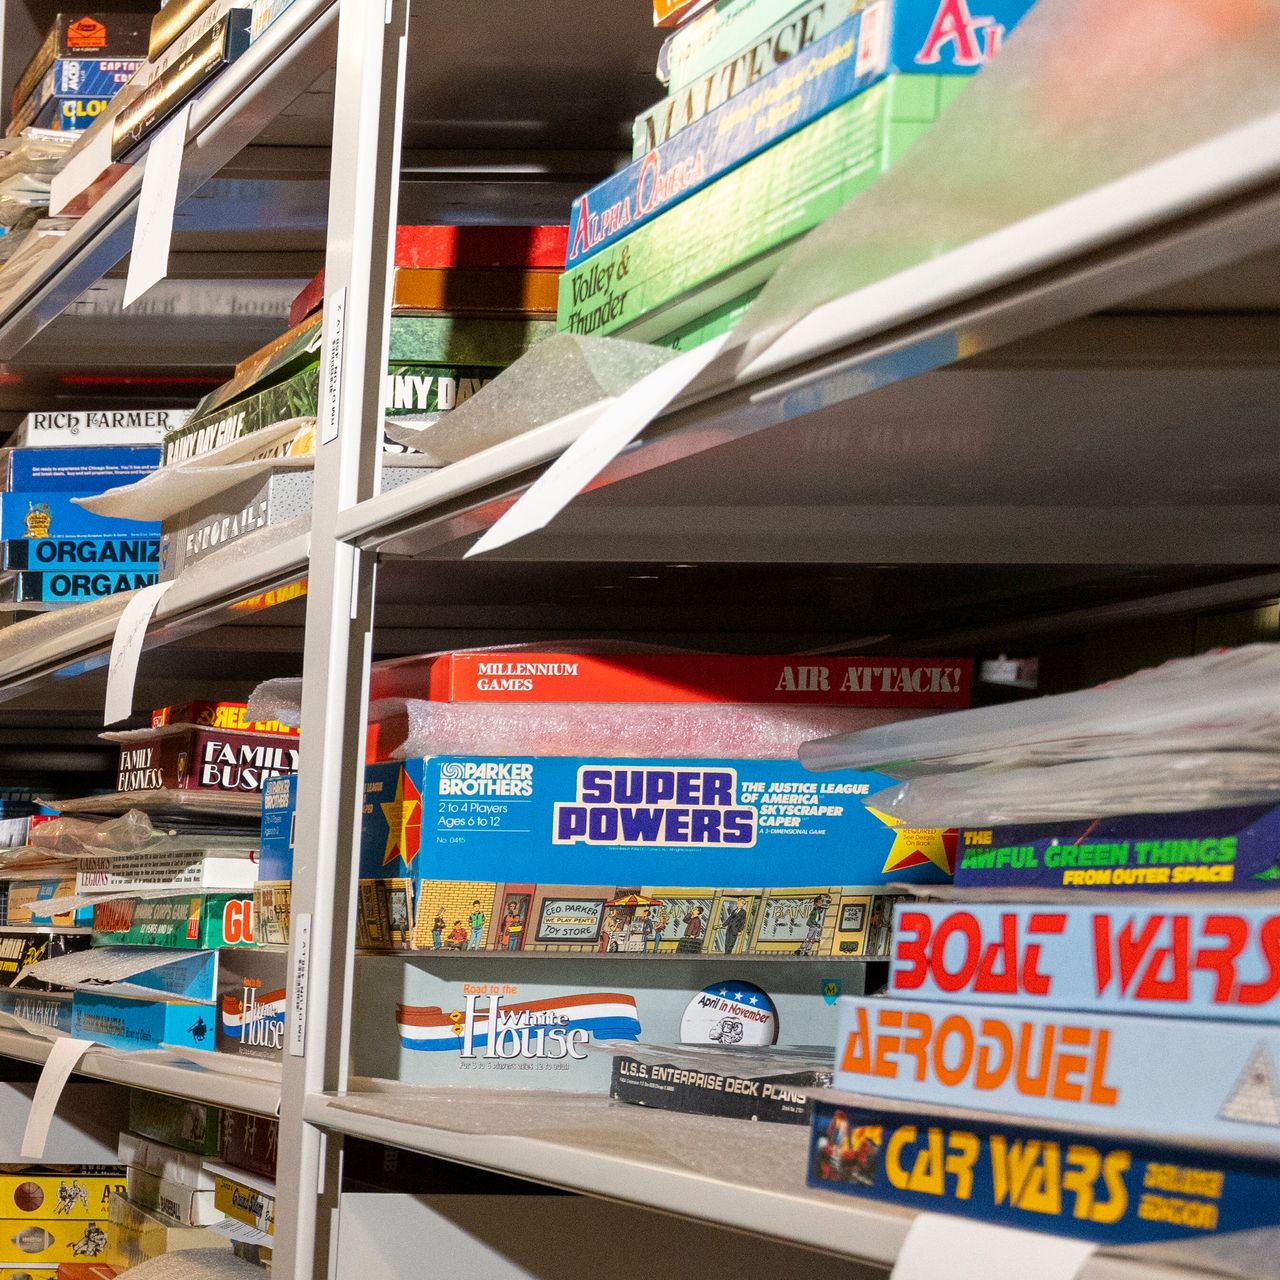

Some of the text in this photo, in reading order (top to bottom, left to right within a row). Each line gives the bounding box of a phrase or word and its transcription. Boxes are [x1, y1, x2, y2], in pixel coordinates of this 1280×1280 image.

[569, 147, 706, 260] ALPHA OMEGA
[85, 411, 174, 432] FARMER
[35, 540, 160, 564] ORGANIZ
[477, 662, 578, 676] MILLENNIUM
[775, 665, 962, 693] AIR ATTACK!
[477, 678, 533, 691] GAMES
[120, 747, 154, 771] FAMILY
[204, 741, 301, 770] FAMILY
[117, 767, 164, 792] BUSINESS
[463, 762, 534, 780] PARKER
[438, 778, 533, 796] BROTHERS
[581, 770, 733, 805] SUPER
[741, 782, 870, 795] THE JUSTICE LEAGUE
[438, 802, 508, 815] 2 to 4 Players
[741, 792, 819, 805] OF AMERICA
[760, 804, 844, 817] SKYSCRAPER
[438, 815, 501, 829] Ages 6 to 12
[558, 807, 754, 845] POWERS
[758, 816, 801, 827] CAPER
[963, 831, 993, 846] THE
[960, 836, 1238, 870] AWFUL GREEN THINGS
[80, 871, 109, 887] LEGIONS
[1063, 865, 1235, 886] FROM OUTER SPACE
[564, 902, 599, 915] PARKER
[544, 925, 592, 936] TOY STORE
[893, 911, 1280, 1005] BOAT WARS
[463, 984, 518, 994] Road to the
[240, 986, 285, 1050] House
[499, 1009, 570, 1027] White
[697, 995, 771, 1024] April in November
[460, 994, 590, 1060] House
[840, 1007, 1120, 1107] AERODUEL
[620, 1061, 649, 1079] U.S.S.
[651, 1065, 724, 1091] ENTERPRISE
[725, 1077, 759, 1097] DECK
[762, 1083, 807, 1105] PLANS
[885, 1124, 1133, 1225] CAR WARS
